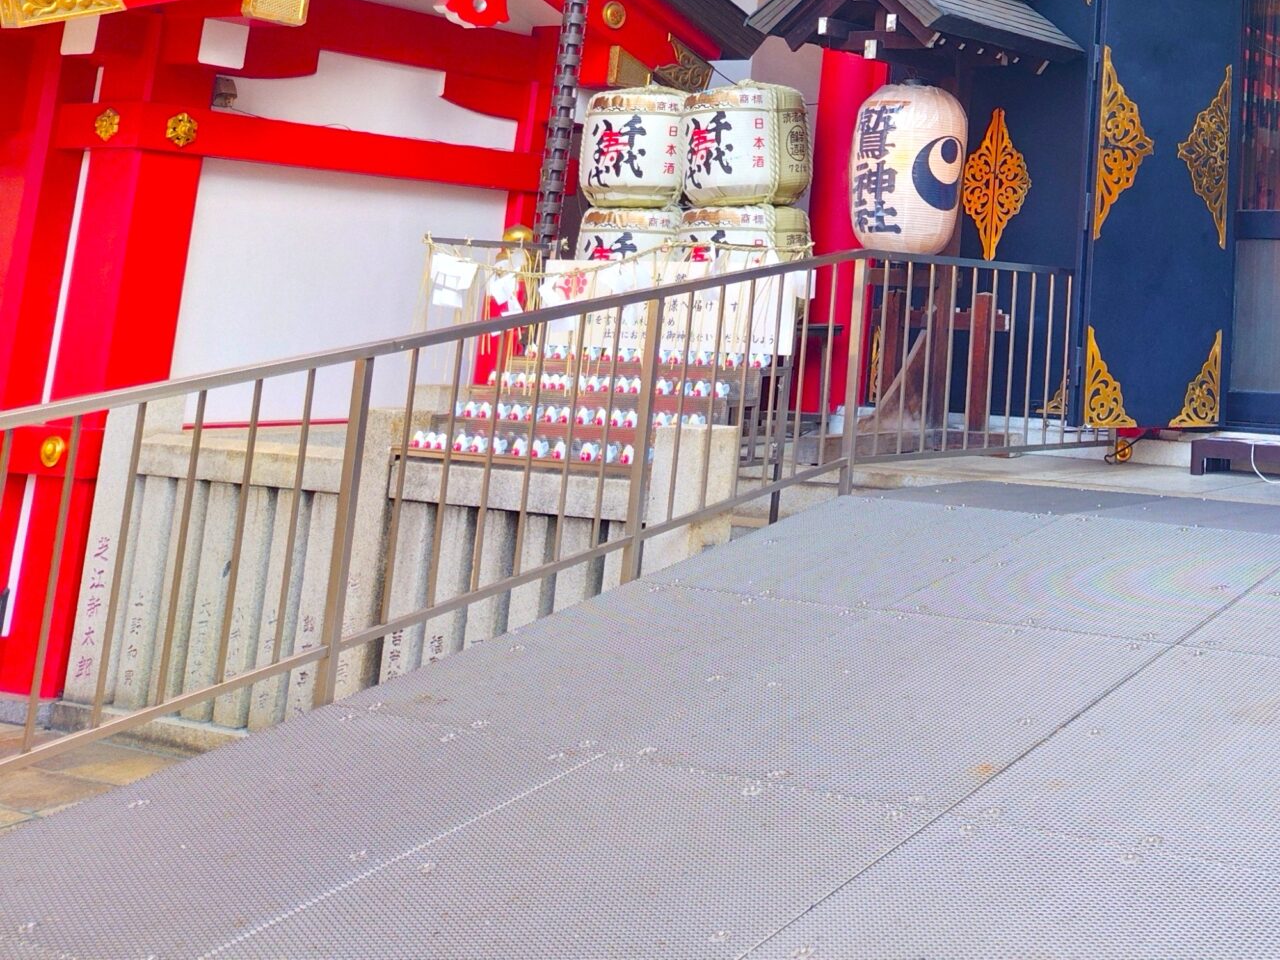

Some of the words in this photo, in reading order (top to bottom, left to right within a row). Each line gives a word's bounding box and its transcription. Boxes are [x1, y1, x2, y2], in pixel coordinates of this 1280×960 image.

[739, 95, 763, 103] 商標
[656, 101, 679, 111] 商標
[752, 118, 765, 168] 日本酒
[663, 126, 678, 174] 日本酒
[741, 213, 764, 224] 商標
